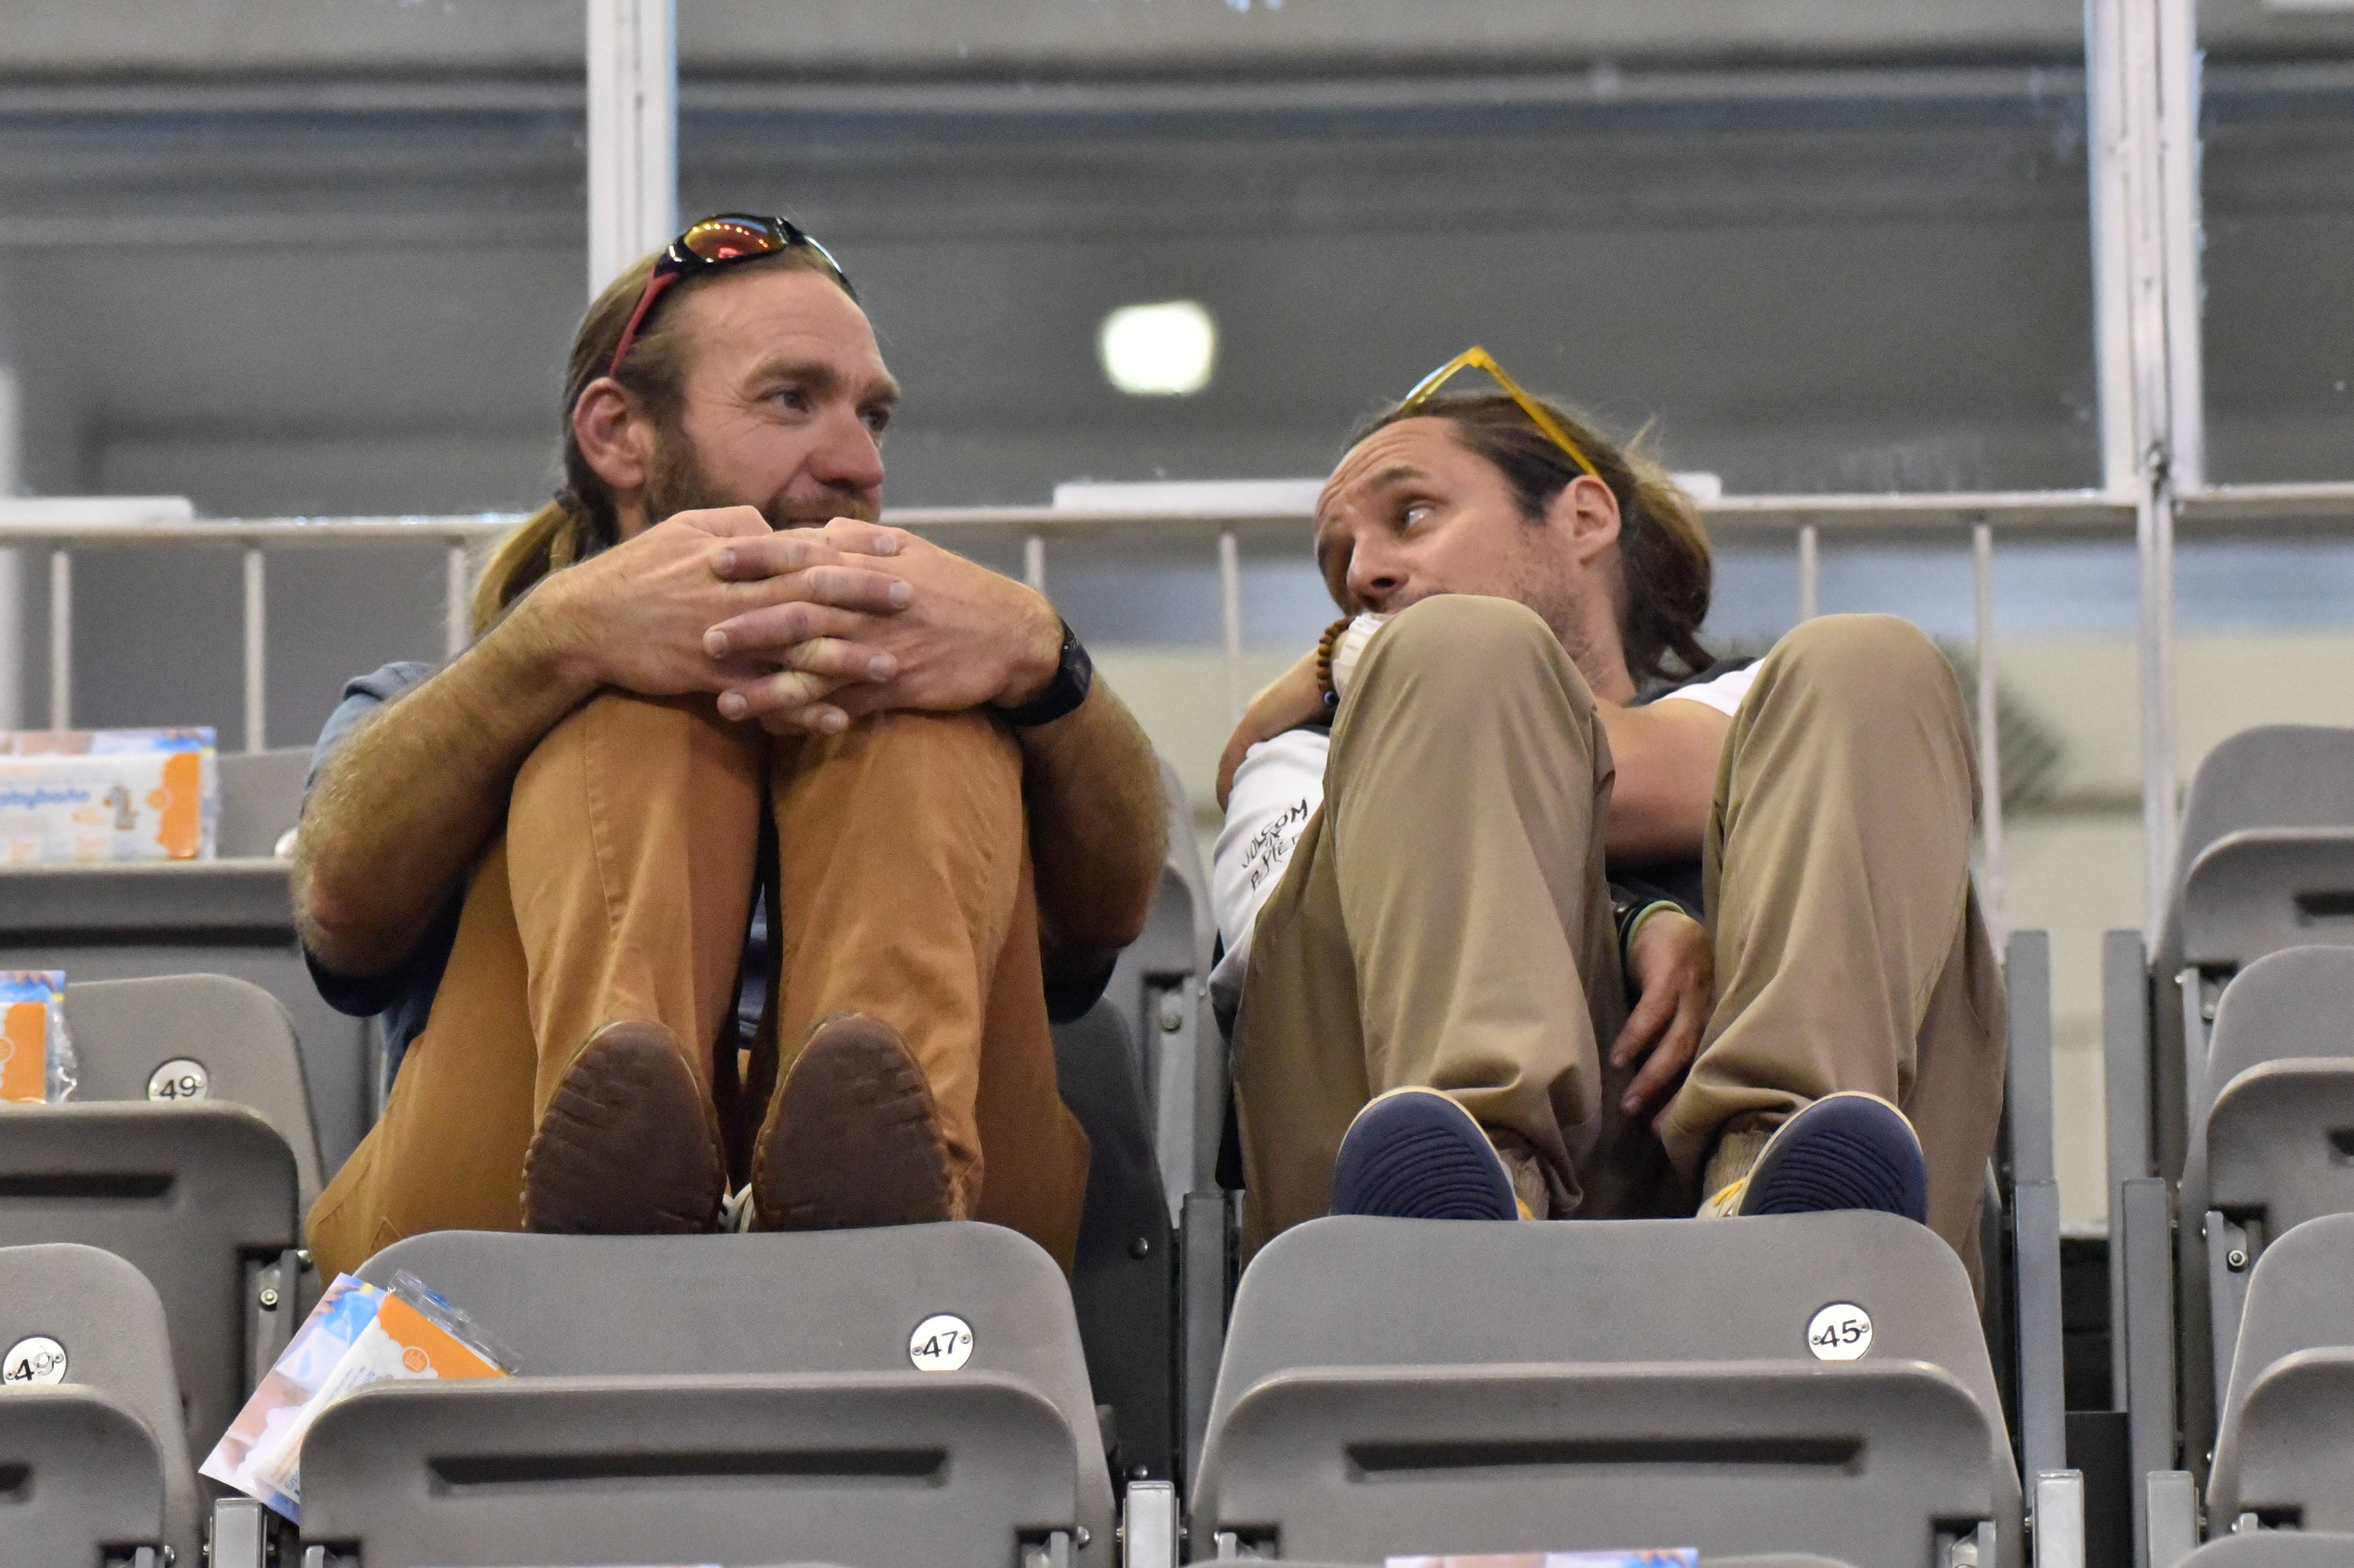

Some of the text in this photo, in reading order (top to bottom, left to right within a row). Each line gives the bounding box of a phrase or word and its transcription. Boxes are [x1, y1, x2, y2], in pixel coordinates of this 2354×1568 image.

[159, 1075, 196, 1100] 49
[923, 1330, 958, 1358] 47
[1820, 1319, 1861, 1347] 45
